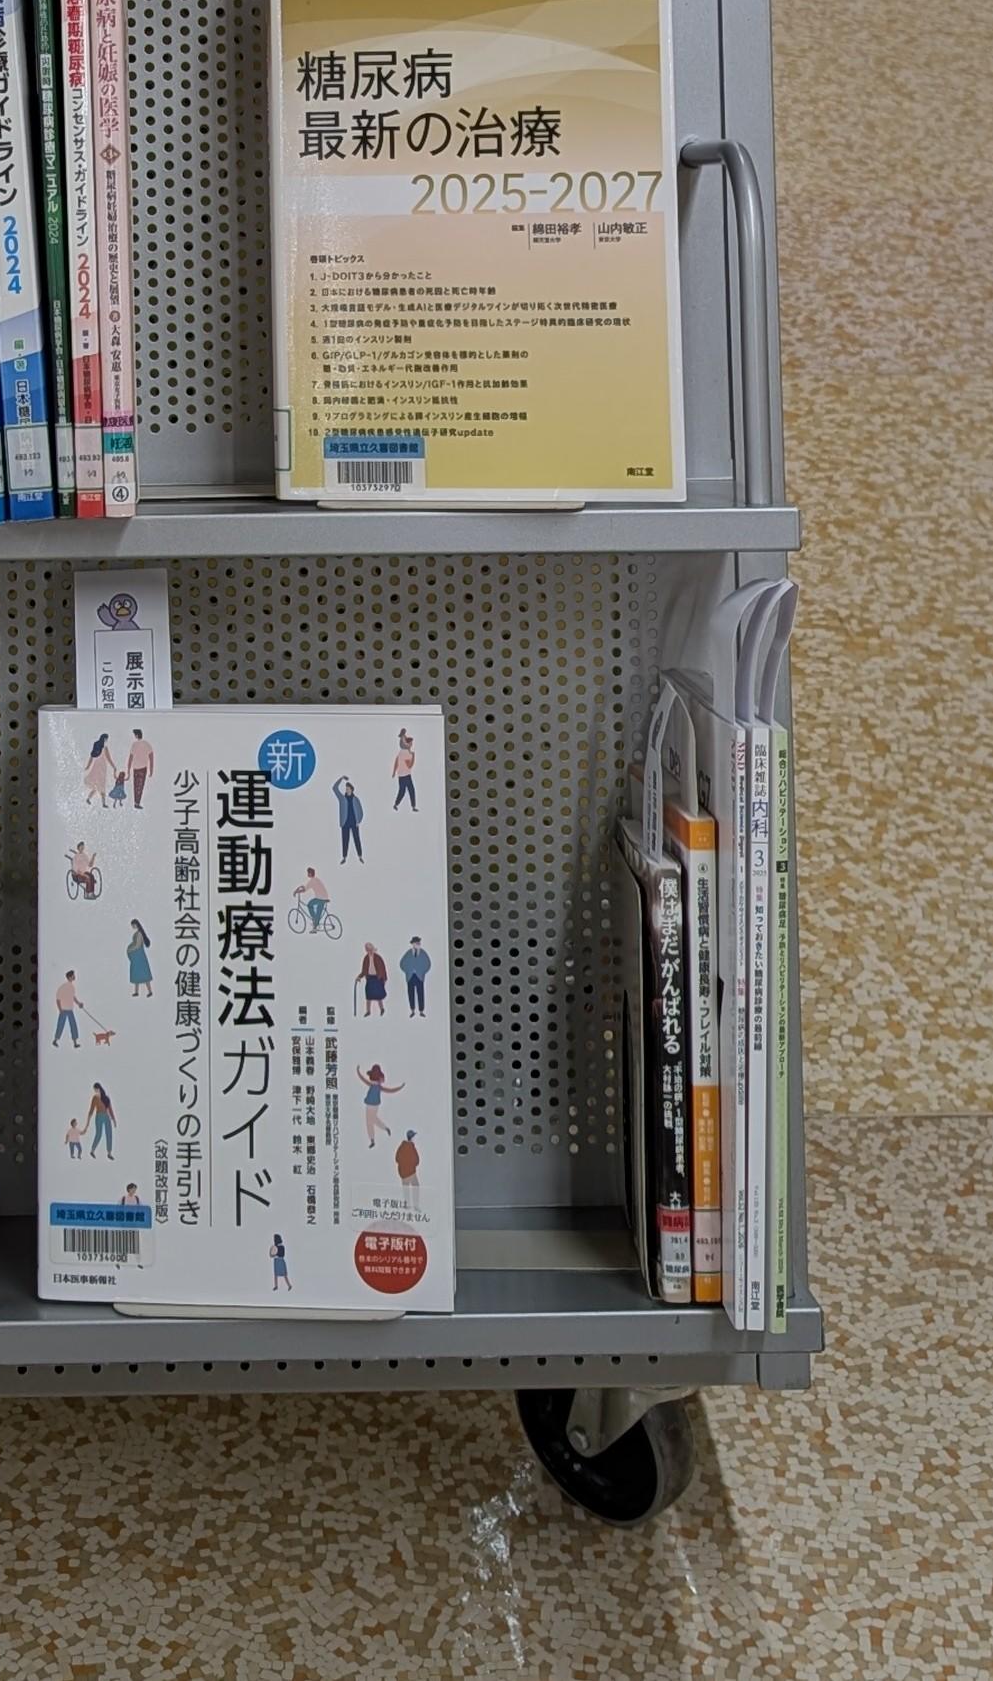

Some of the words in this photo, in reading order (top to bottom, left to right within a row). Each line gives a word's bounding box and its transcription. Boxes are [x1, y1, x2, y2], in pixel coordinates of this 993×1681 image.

[296, 48, 453, 101] 糖尿病
[298, 106, 561, 161] 最新の治療
[411, 170, 663, 215] 2025-2027
[47, 216, 59, 245] 2024
[597, 221, 648, 235] 山内敏正
[3, 216, 22, 295] 2024
[77, 253, 92, 319] 2024
[626, 465, 655, 478] 南江堂
[268, 741, 307, 781] 新
[754, 744, 766, 797] 臨床雑誌
[751, 799, 768, 838] 内科
[754, 849, 764, 867] 3
[658, 878, 682, 1054] 僕はまだがんばれる
[173, 769, 202, 1225] 少子高齢社会の健康づくりの手引き
[217, 768, 276, 1229] 運動療法ガイド
[154, 1138, 168, 1224] 〈改題改訂版〉
[364, 1236, 417, 1252] 電子版付
[53, 1273, 117, 1286] 日本医事新報社
